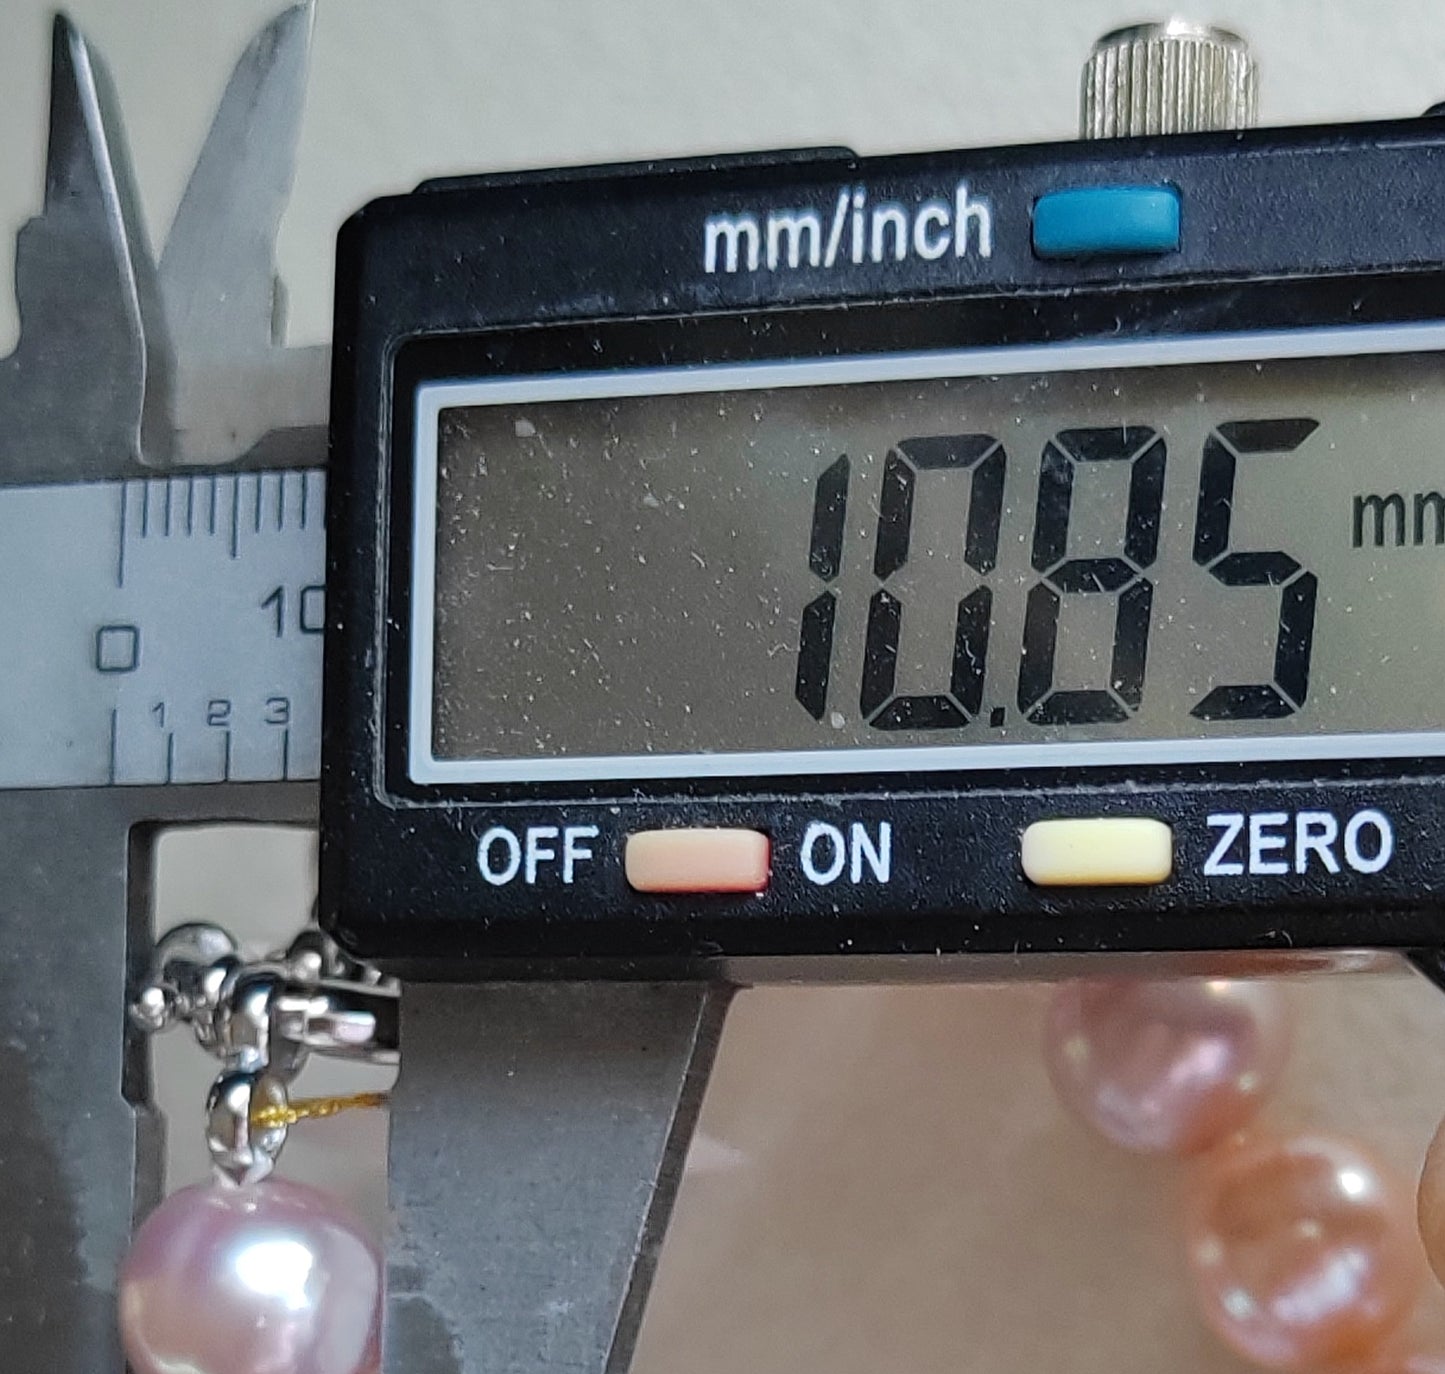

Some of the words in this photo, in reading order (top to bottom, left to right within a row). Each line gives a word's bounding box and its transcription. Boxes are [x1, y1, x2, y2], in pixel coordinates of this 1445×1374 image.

[702, 180, 993, 275] mm/inch
[795, 417, 1321, 732] 10.85
[260, 584, 327, 638] 10
[95, 624, 139, 673] 0
[151, 701, 166, 728] 1
[206, 699, 232, 726] 2
[263, 696, 289, 725] 3
[476, 825, 599, 886] OFF
[800, 822, 893, 885] ON
[1203, 811, 1395, 876] ZERO
